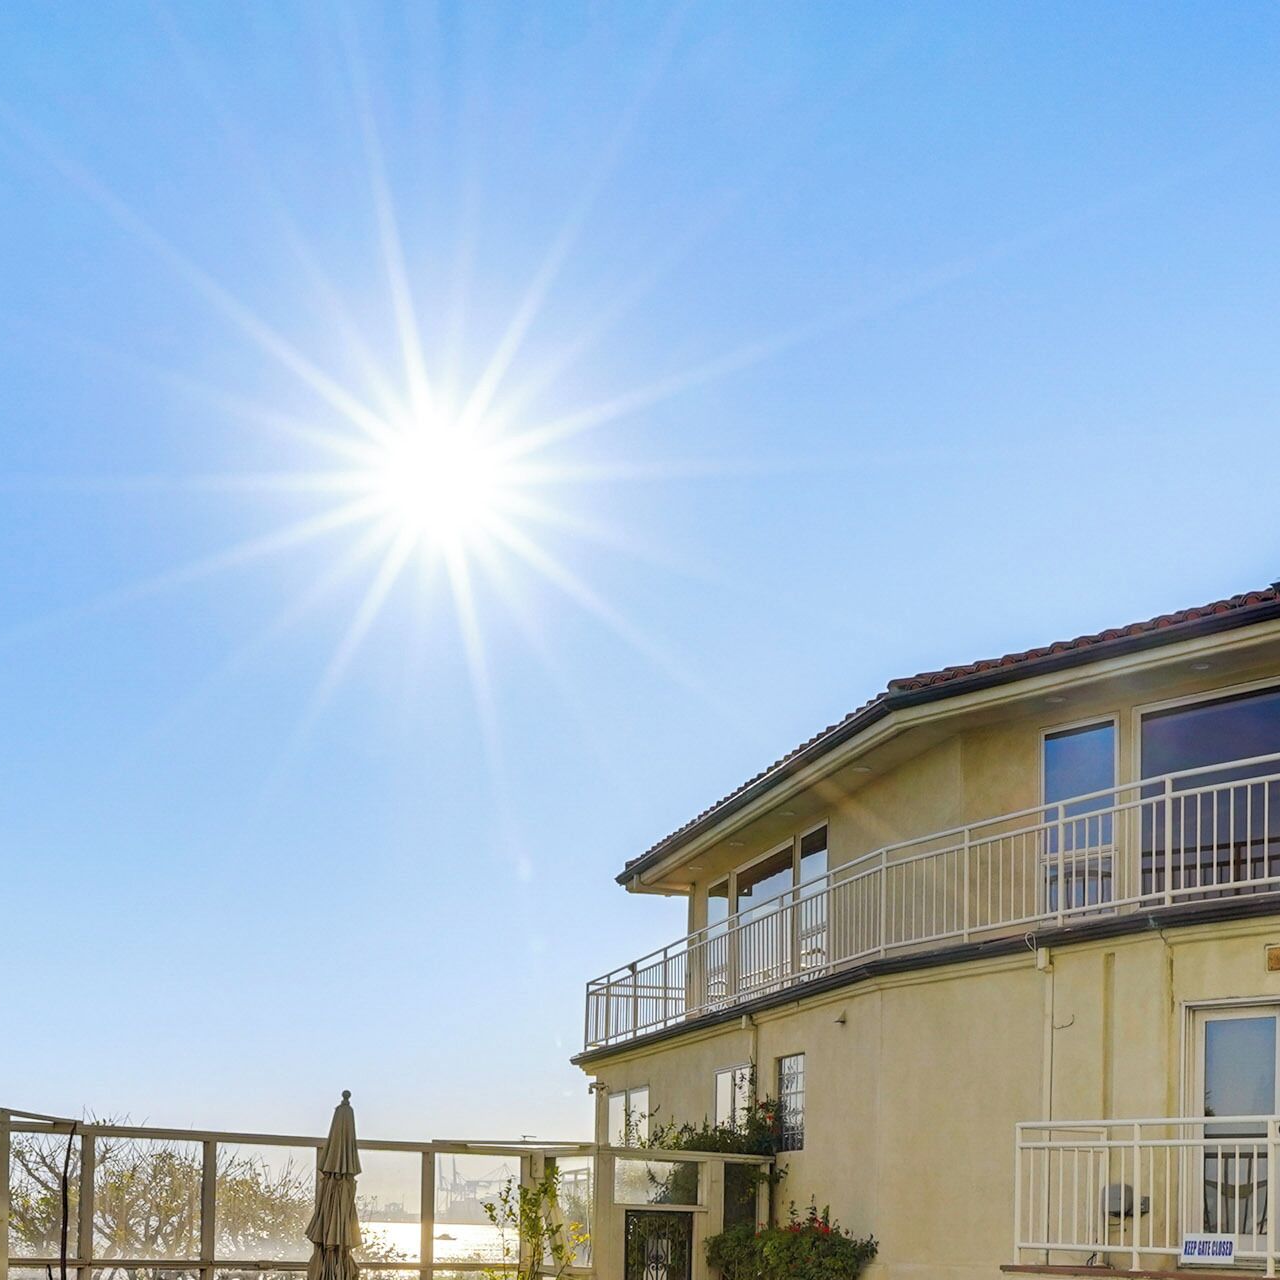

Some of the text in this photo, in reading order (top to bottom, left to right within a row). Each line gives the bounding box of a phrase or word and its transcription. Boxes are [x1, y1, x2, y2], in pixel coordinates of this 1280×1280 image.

[1184, 1240, 1233, 1256] KEEP GATE CLOSED
